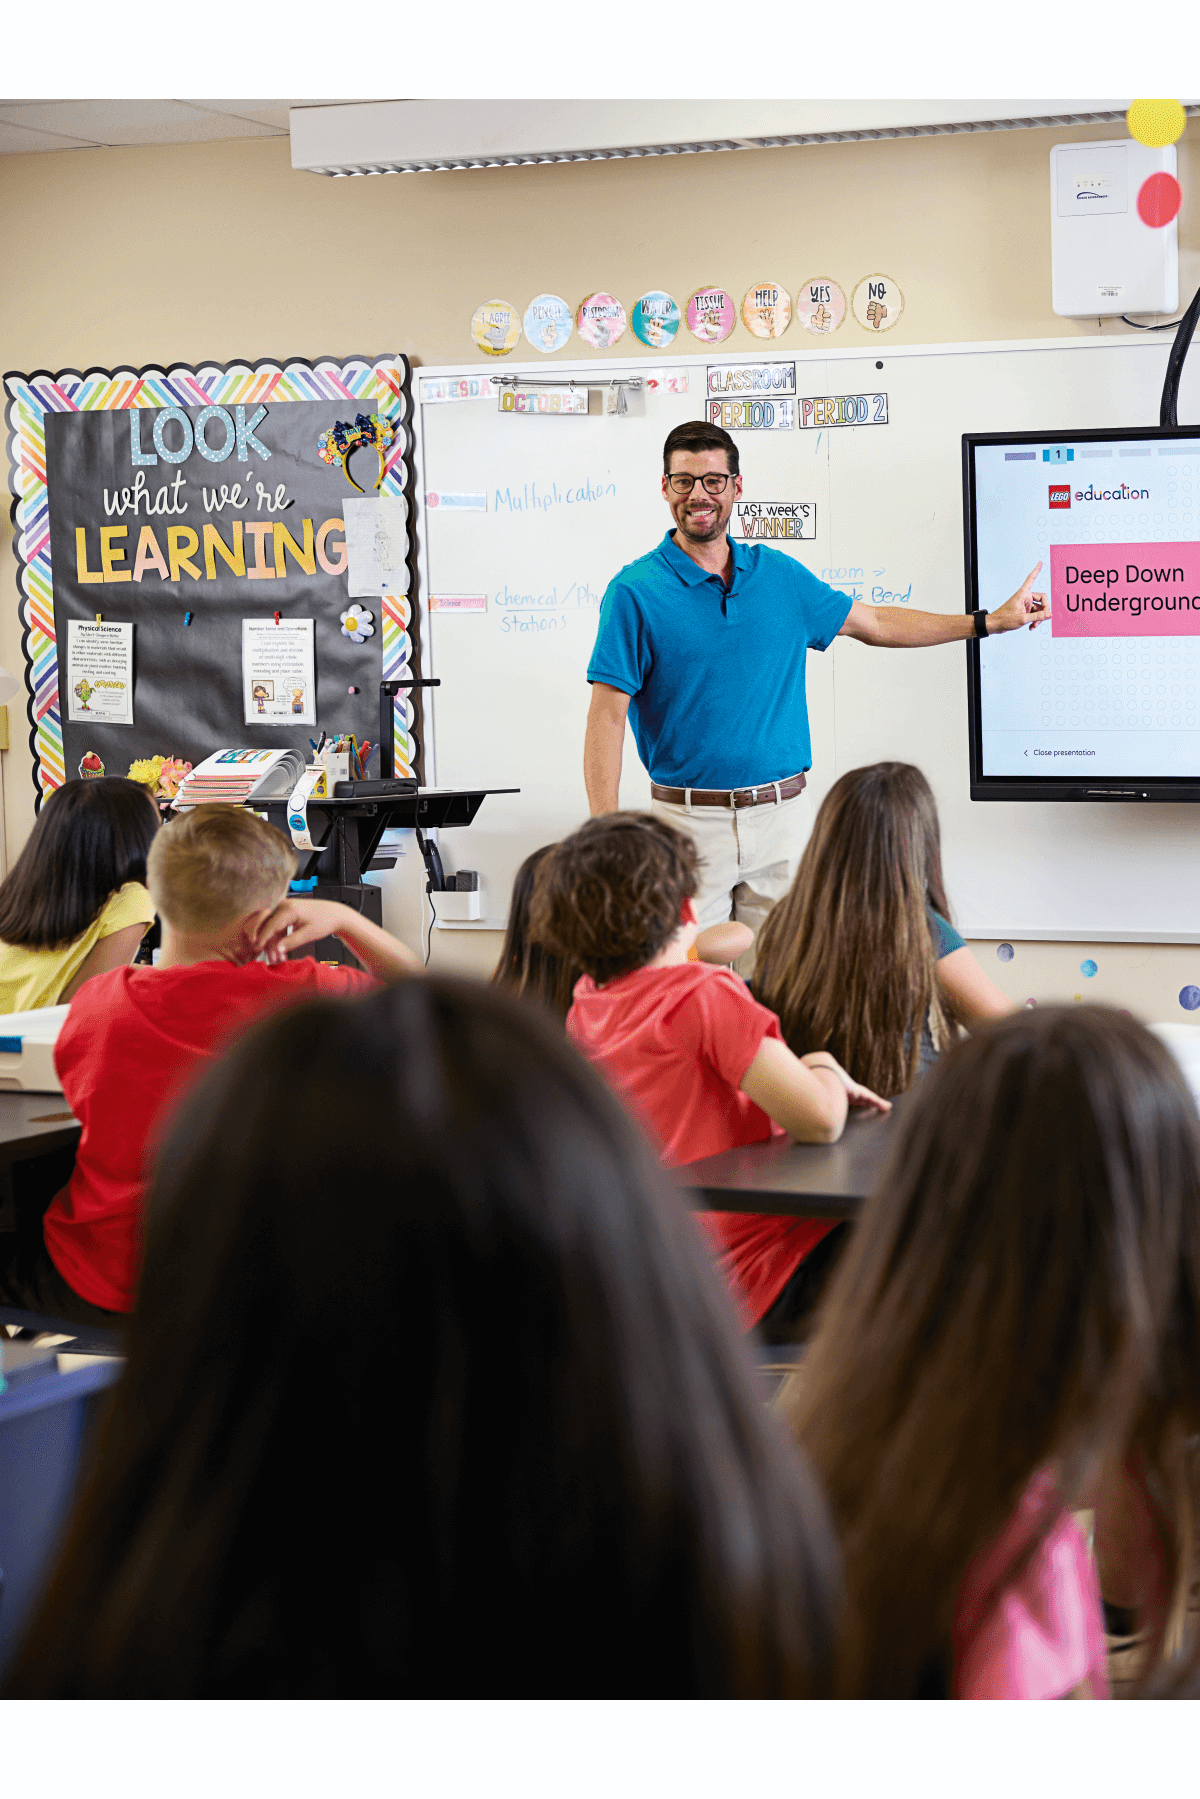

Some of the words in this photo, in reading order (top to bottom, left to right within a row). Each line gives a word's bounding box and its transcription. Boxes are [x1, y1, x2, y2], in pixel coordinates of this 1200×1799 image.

[755, 289, 779, 308] HELP
[810, 285, 831, 303] YES
[868, 282, 887, 300] NO
[640, 299, 672, 315] WATER
[695, 294, 725, 311] TISSUE
[482, 312, 485, 323] I
[489, 312, 511, 324] AGREE
[532, 304, 562, 320] PENCIL
[582, 306, 620, 319] RESTROOM
[708, 367, 795, 392] CLASSROOM
[424, 378, 499, 400] TUESDA
[710, 402, 775, 428] PERIOD
[779, 402, 790, 427] 1
[802, 397, 869, 426] PERIOD
[873, 395, 886, 422] 2
[130, 404, 272, 466] LOOK
[1056, 450, 1060, 458] 1
[103, 470, 188, 516] what
[202, 470, 290, 514] we're
[495, 477, 616, 512] Multiplication
[1050, 492, 1070, 502] LEGO
[1075, 484, 1149, 500] education
[741, 517, 804, 538] WINNER
[75, 517, 349, 584] LEARNING
[1066, 566, 1119, 588] Deep
[1126, 565, 1184, 582] Down
[871, 583, 912, 603] Bend
[439, 599, 461, 607] Science
[499, 614, 566, 632] Stations
[1054, 749, 1096, 757] presentation
